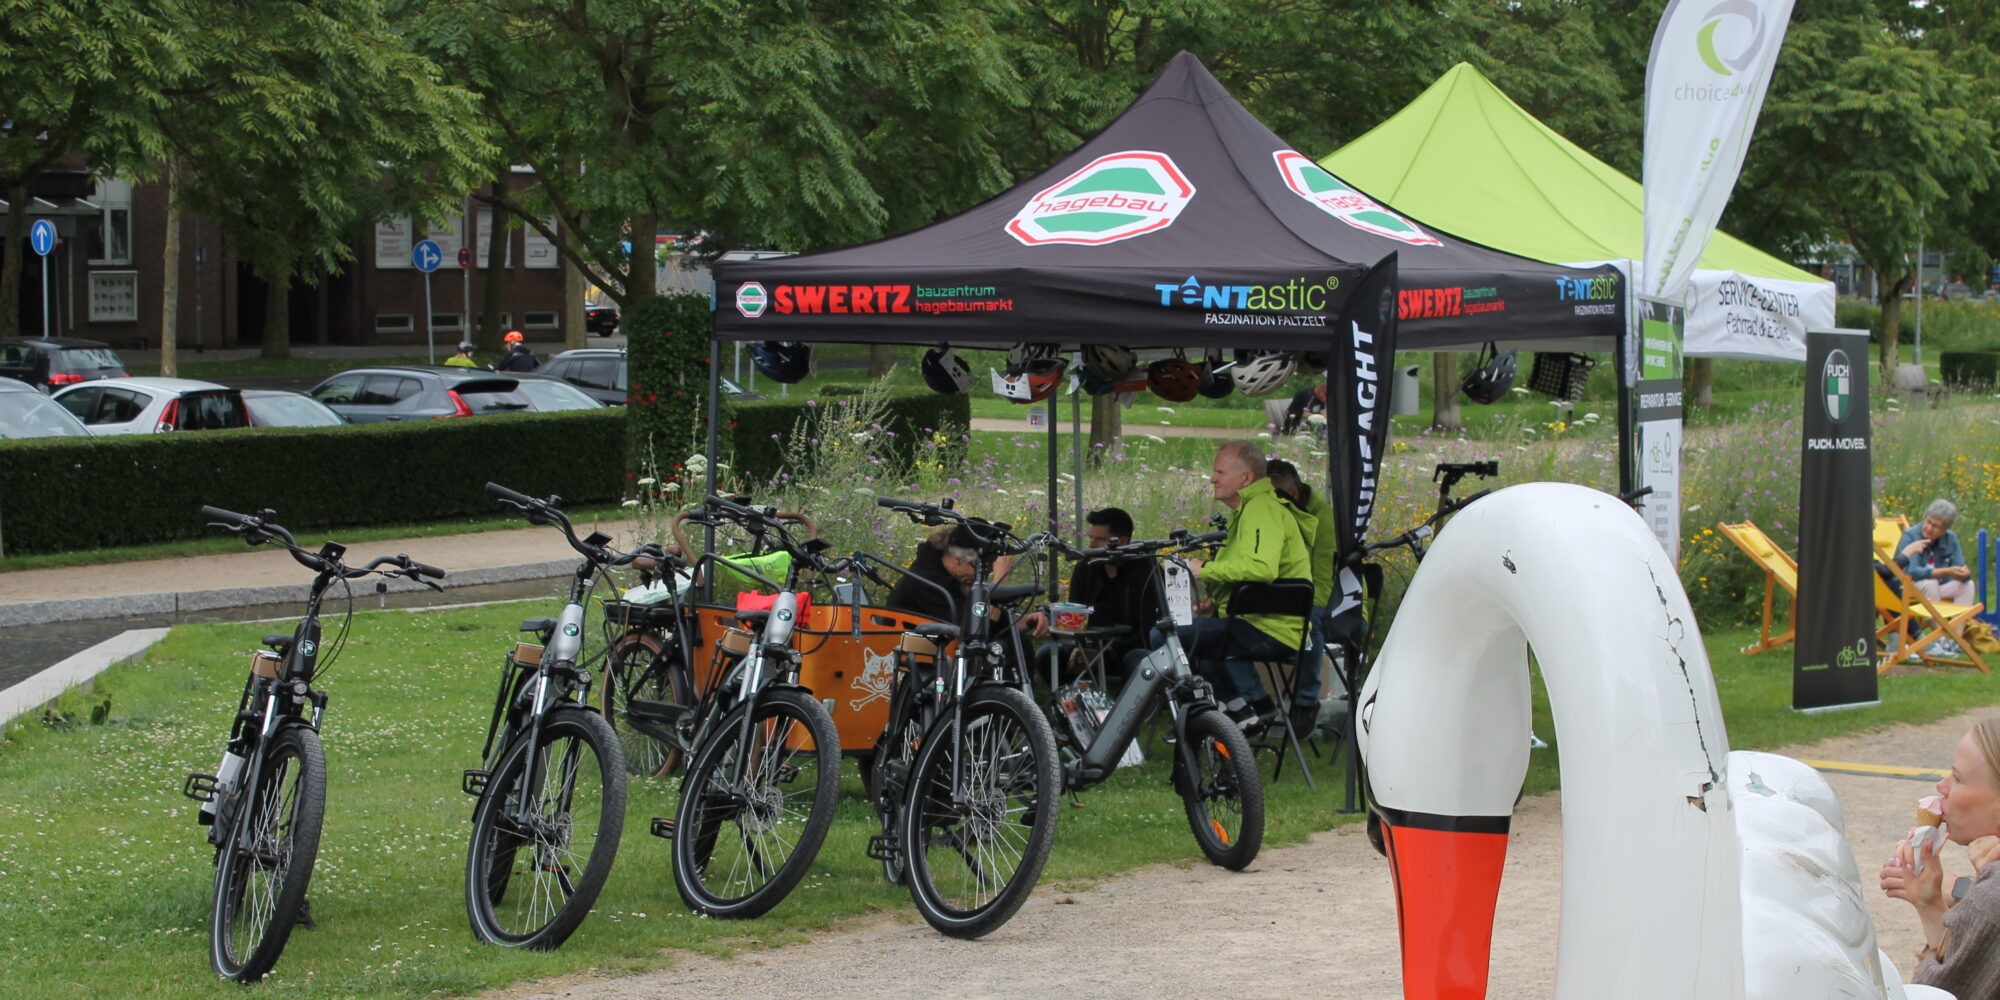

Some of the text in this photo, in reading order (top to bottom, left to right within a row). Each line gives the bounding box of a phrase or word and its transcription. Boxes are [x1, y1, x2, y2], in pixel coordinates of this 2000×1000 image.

[1034, 193, 1168, 215] hagebau
[774, 285, 911, 314] SWERTZ
[916, 284, 996, 297] bauzentrum
[1718, 280, 1800, 317] SERVICE-CENTER
[915, 299, 1013, 315] hagebaumarkt
[1397, 287, 1463, 320] SWERTZ
[1205, 313, 1327, 327] FASZINATION FALTZELT
[1726, 312, 1758, 336] Fahrrad
[1759, 315, 1767, 337] &
[1827, 364, 1850, 377] PUCH
[1808, 437, 1867, 450] PUCH. MOVES.
